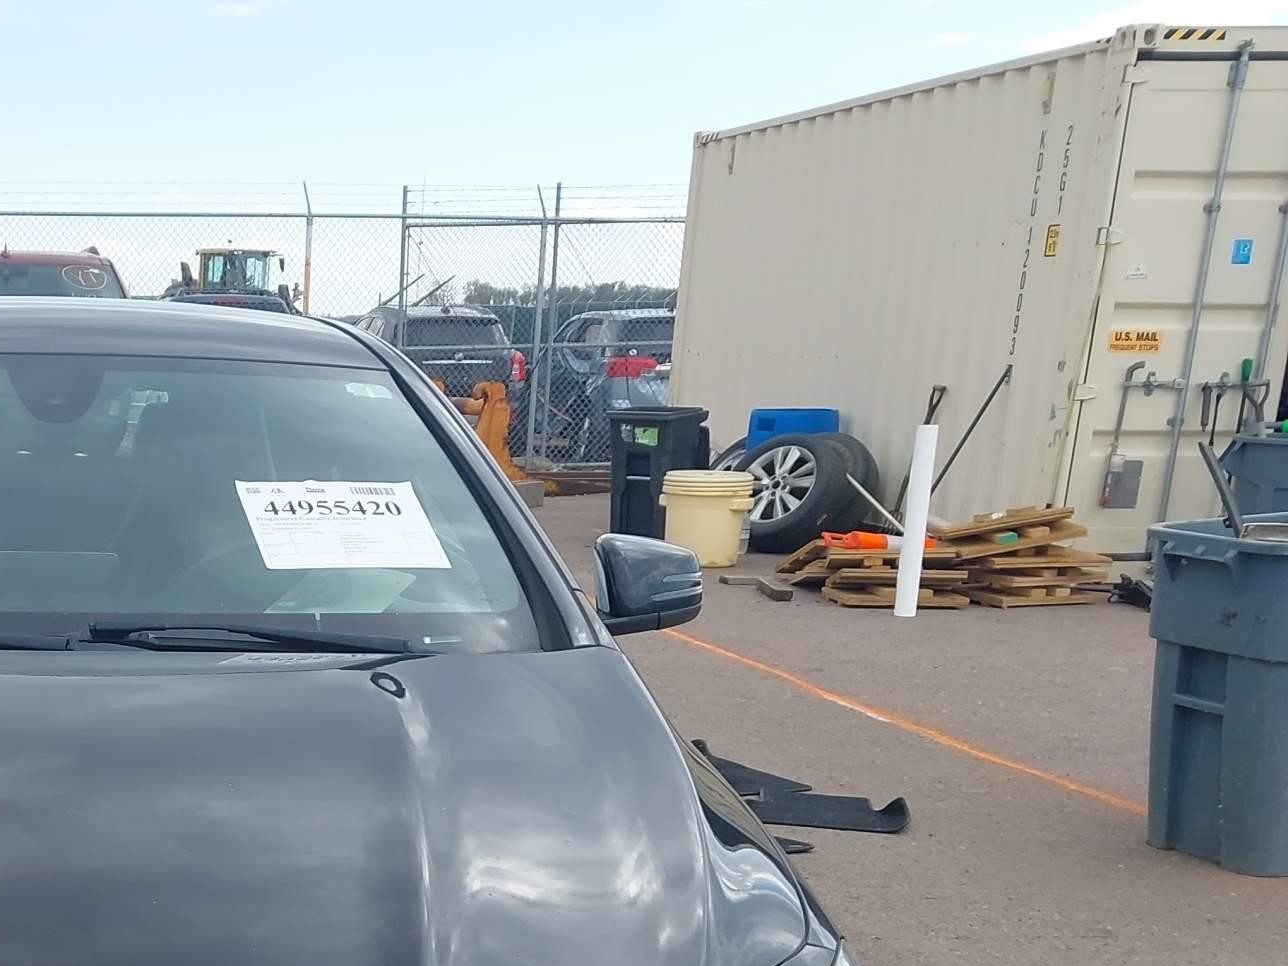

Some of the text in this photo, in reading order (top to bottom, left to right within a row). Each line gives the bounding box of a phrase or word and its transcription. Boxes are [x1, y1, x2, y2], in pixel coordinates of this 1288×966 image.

[1114, 331, 1159, 342] U.S. MAIL
[1137, 343, 1159, 352] STOPS
[263, 500, 402, 517] 44955420
